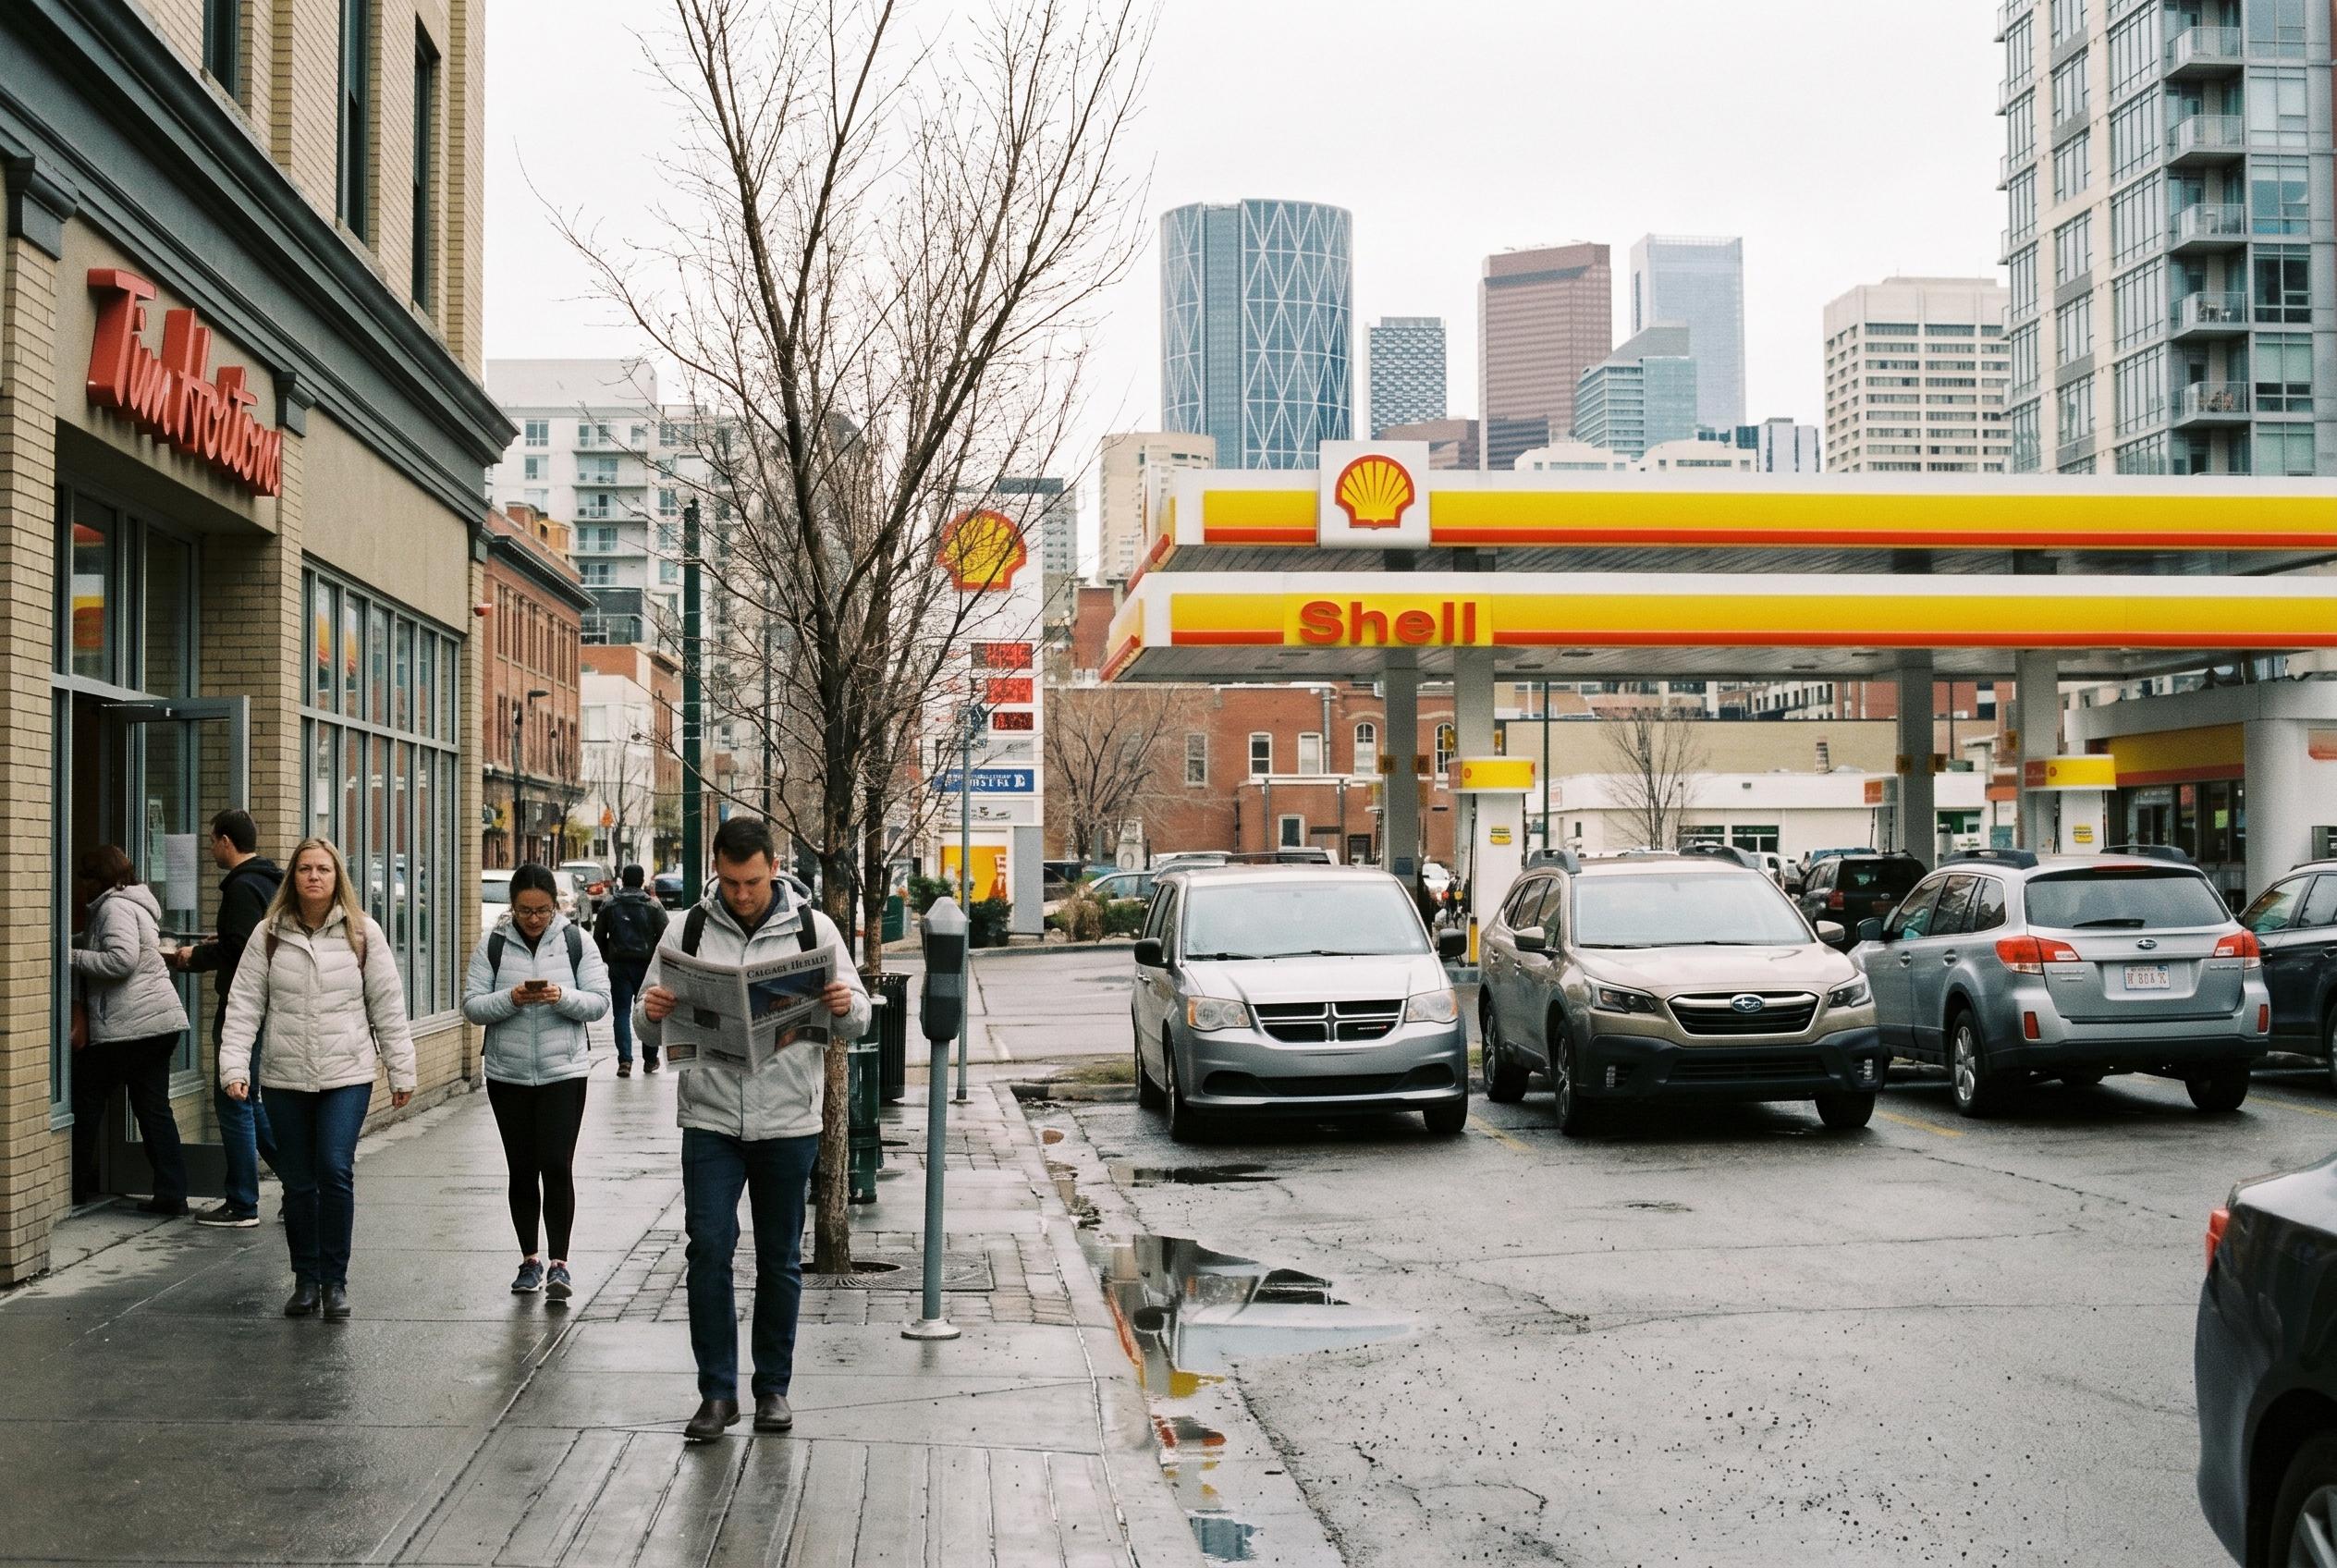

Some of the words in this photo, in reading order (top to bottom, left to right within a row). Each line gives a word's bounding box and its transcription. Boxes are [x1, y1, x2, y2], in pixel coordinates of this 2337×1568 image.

[87, 268, 172, 438] Tim
[164, 308, 283, 496] Hortons
[1299, 601, 1476, 643] Shell
